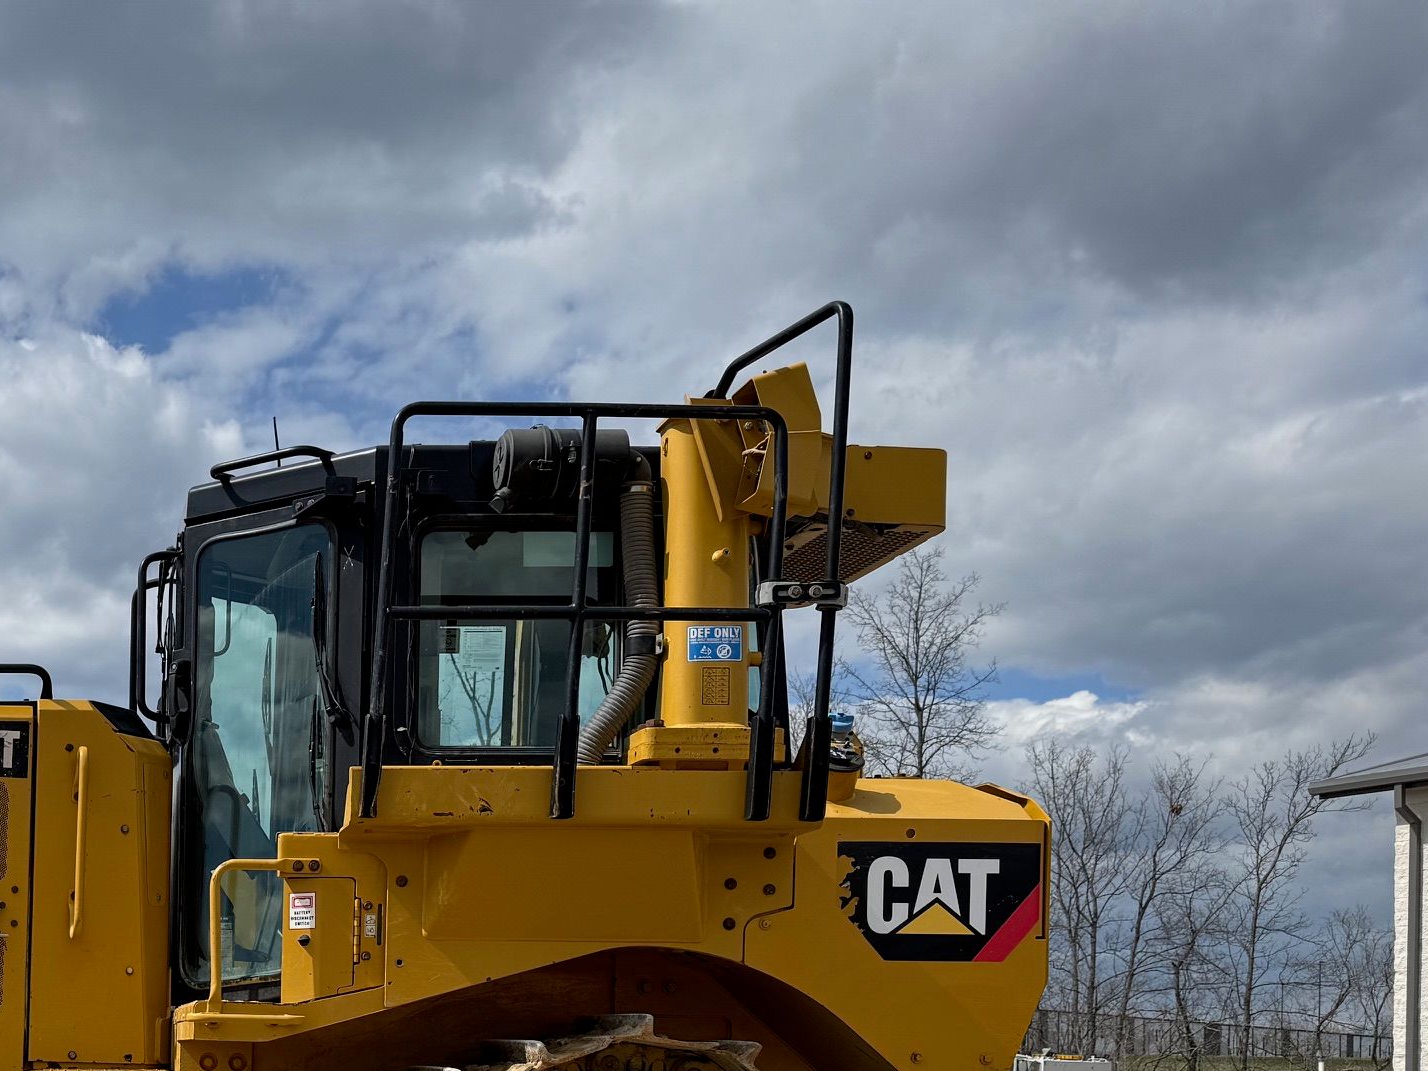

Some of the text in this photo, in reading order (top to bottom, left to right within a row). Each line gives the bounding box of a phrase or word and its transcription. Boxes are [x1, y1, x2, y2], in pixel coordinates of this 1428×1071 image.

[690, 627, 740, 638] DEF ONLY
[866, 855, 1000, 936] CAT
